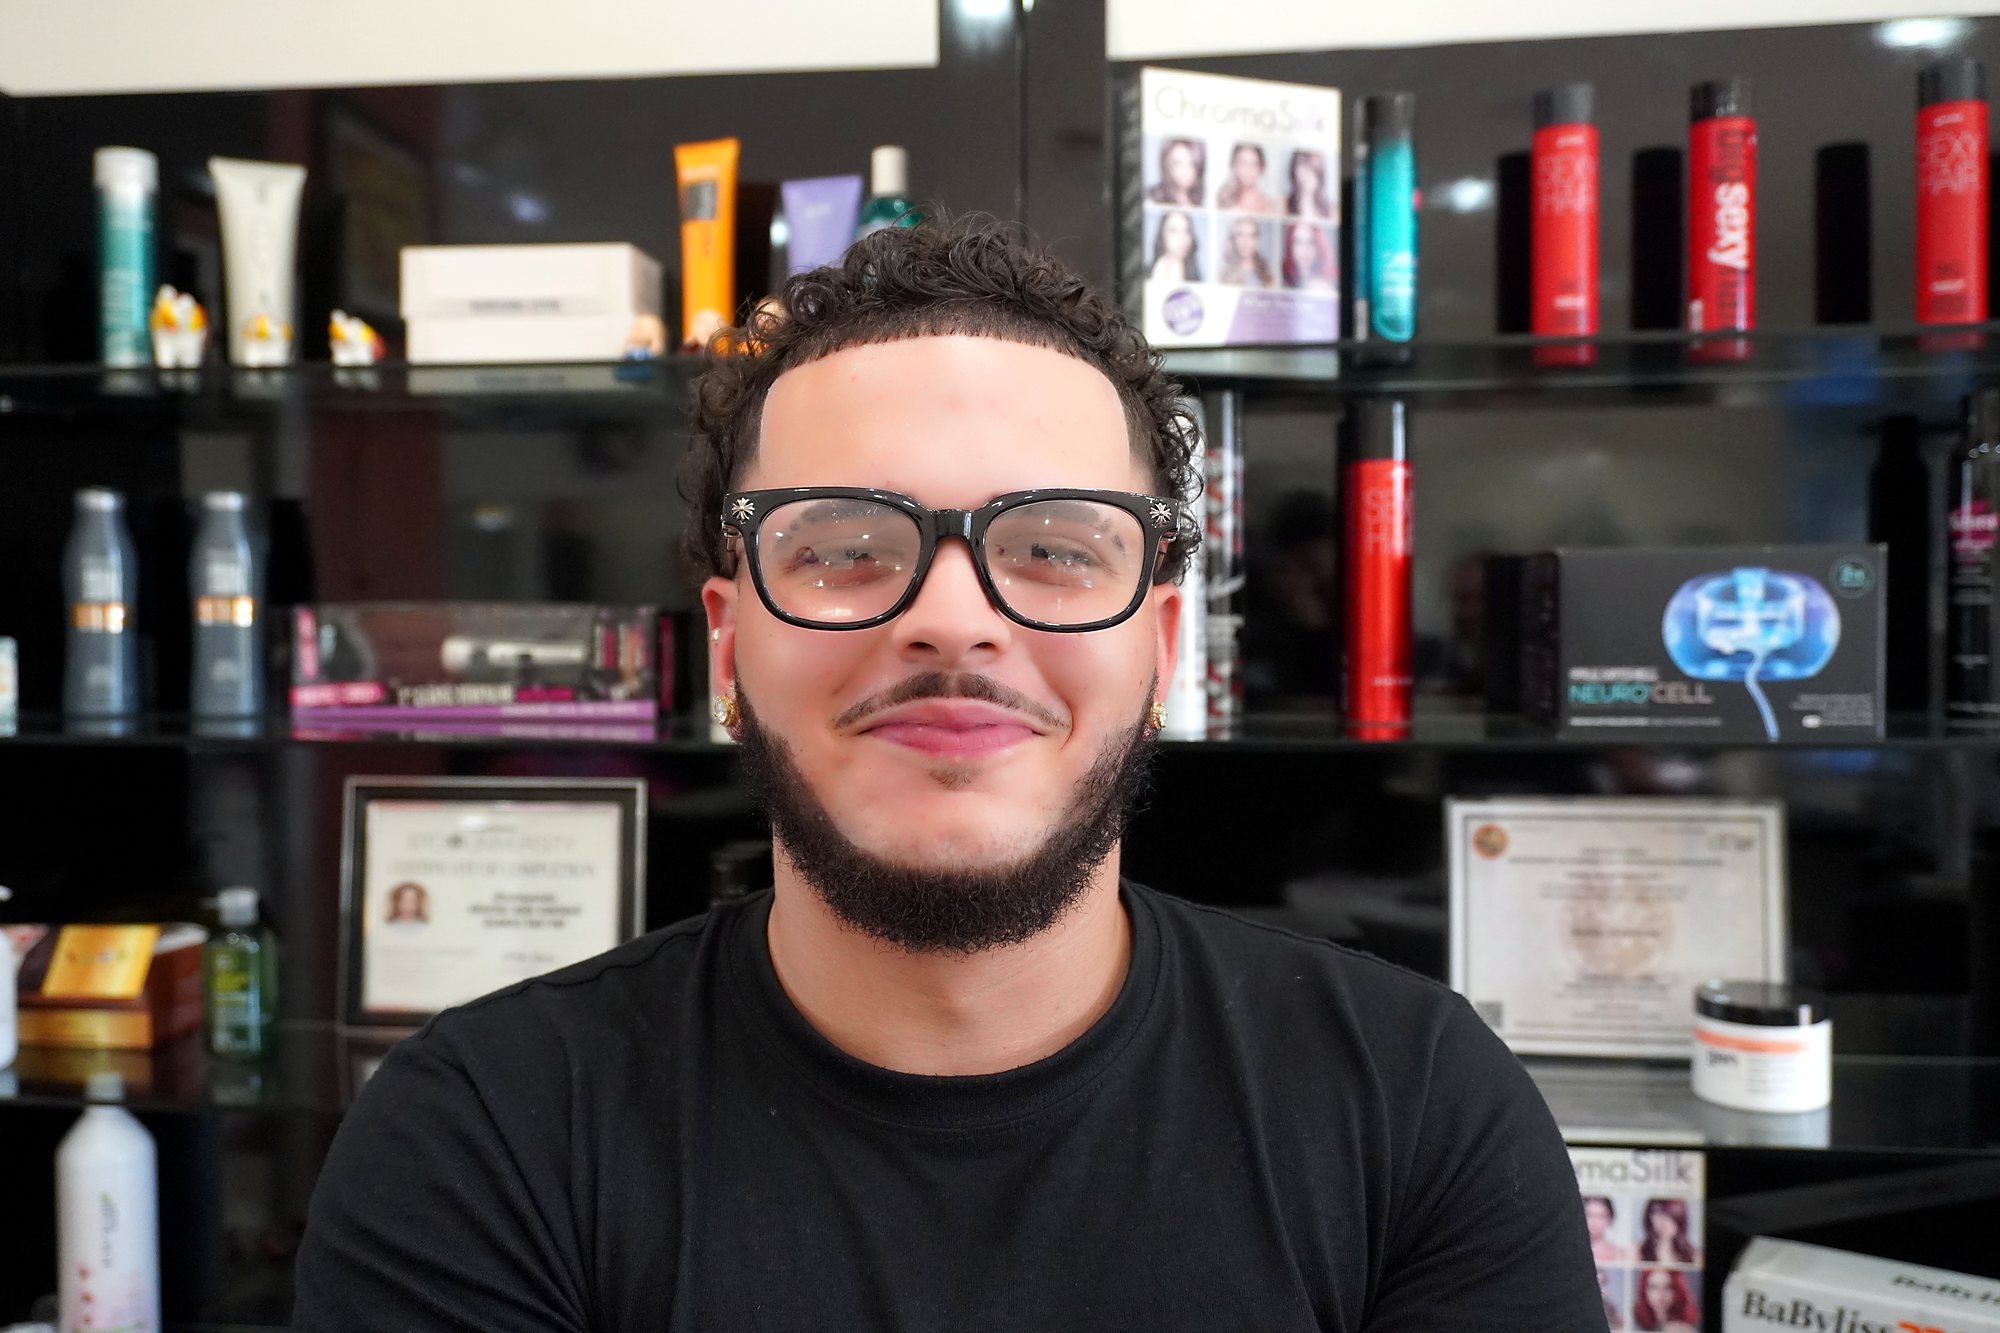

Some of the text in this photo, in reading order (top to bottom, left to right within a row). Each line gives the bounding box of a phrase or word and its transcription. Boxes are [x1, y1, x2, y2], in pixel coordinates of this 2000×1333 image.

[1155, 86, 1325, 132] ChromaSilk
[1707, 182, 1749, 270] sexy
[1568, 682, 1713, 704] NEURO CELL
[1577, 1149, 1694, 1184] maSilk
